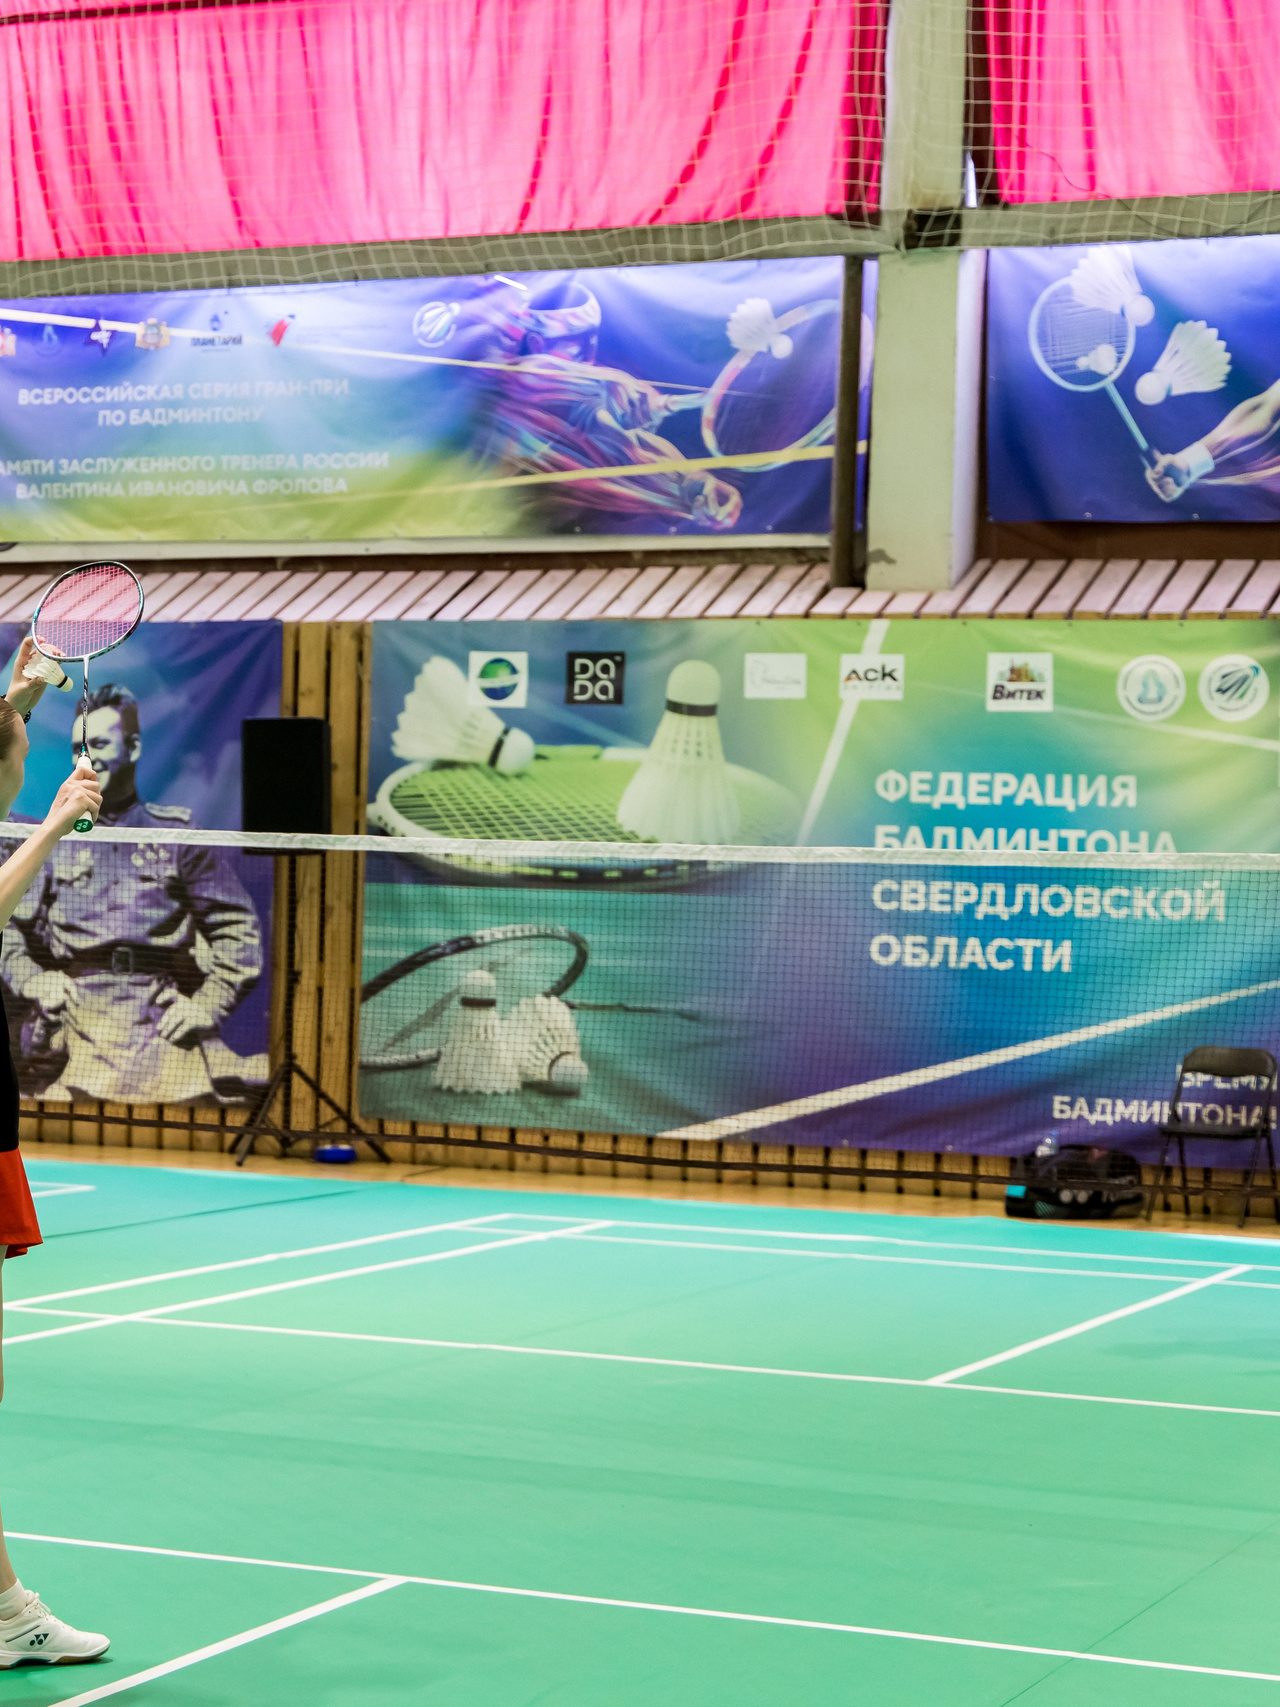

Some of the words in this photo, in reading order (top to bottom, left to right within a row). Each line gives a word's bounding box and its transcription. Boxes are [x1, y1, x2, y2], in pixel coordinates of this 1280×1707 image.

[18, 381, 184, 405] ВСЕРОССИЙСКАЯ
[188, 382, 251, 399] СЕРИЯ
[254, 378, 350, 397] ГРАН-ПРИ
[98, 410, 126, 426] ПО
[129, 406, 264, 426] БАДМИНТОНУ
[58, 456, 215, 475] ЗАСЛУЖЕННОГО
[221, 454, 298, 471] ТРЕНЕРА
[303, 452, 389, 470] РОССИИ
[16, 482, 124, 499] ВАЛЕНТИНА
[129, 480, 248, 497] ИВАНОВИЧА
[252, 477, 348, 495] ФРОЛОВА
[874, 769, 1138, 812] ФЕДЕРАЦИЯ
[873, 824, 1179, 854] БАДМИНТОНА
[871, 879, 1226, 921] СВЕРДЛОВСКОЙ
[870, 933, 1072, 972] ОБЛАСТИ
[1052, 1095, 1278, 1130] БАДМИНТОНА!
